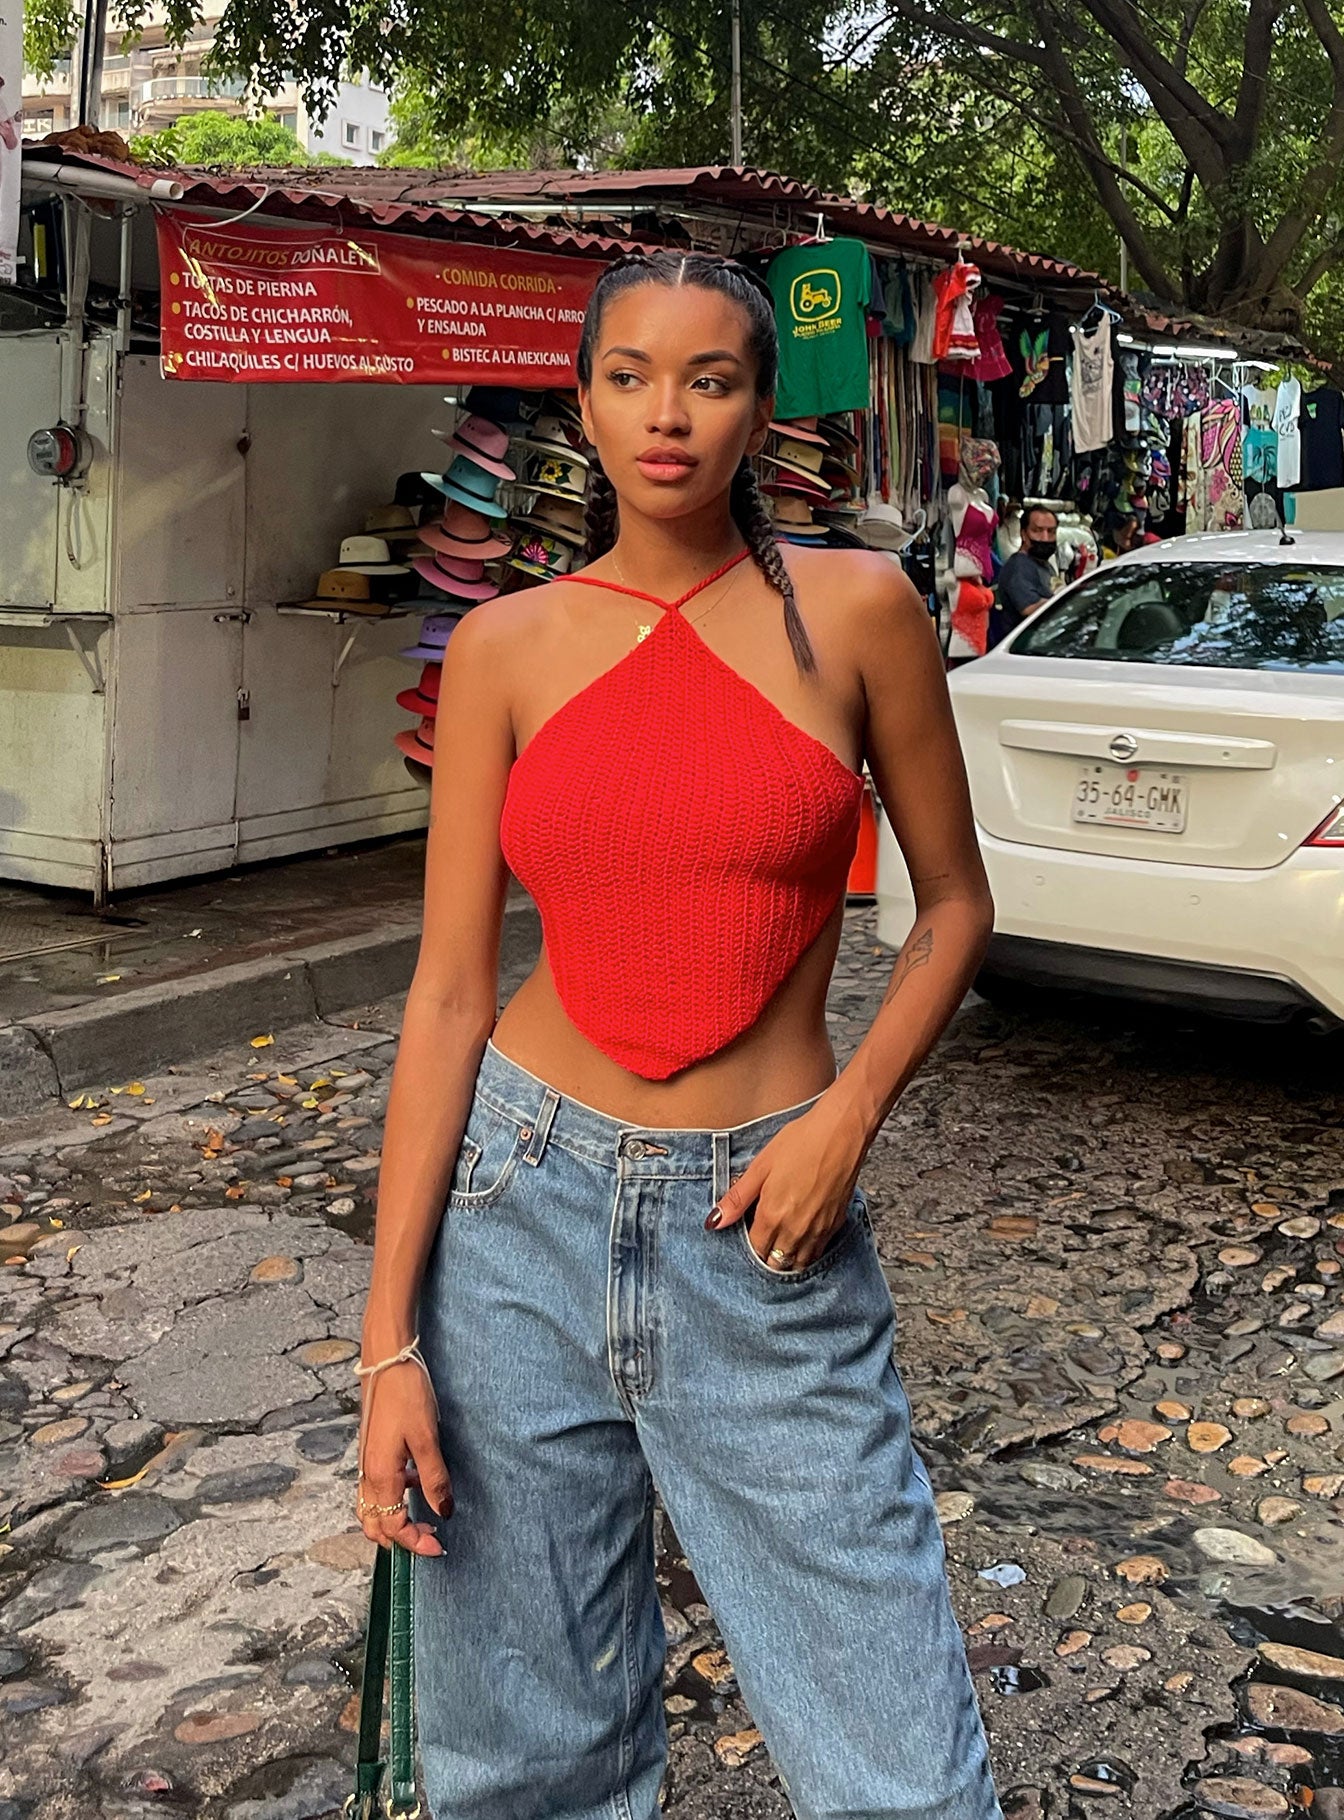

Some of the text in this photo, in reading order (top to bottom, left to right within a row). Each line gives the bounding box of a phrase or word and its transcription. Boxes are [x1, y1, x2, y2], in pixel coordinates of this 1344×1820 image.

[189, 239, 289, 265] ANTOJITOS
[291, 245, 338, 265] DOÑA
[236, 279, 255, 295] DE
[257, 281, 317, 297] PIERNA
[183, 300, 353, 328] TACOS DE CHICHARRÓN,
[416, 297, 587, 324] PESCADO A LA PLANCHA C/ ARRO
[184, 323, 332, 344] COSTILLA Y LENGUA
[417, 318, 487, 336] Y ENSALADA
[794, 324, 817, 334] JOHN
[186, 350, 415, 373] CHILAQUILES C/ HUEVOS AL GUSTO
[452, 348, 571, 366] BISTEC A LA MEXICANA
[1104, 807, 1152, 818] JALISCO
